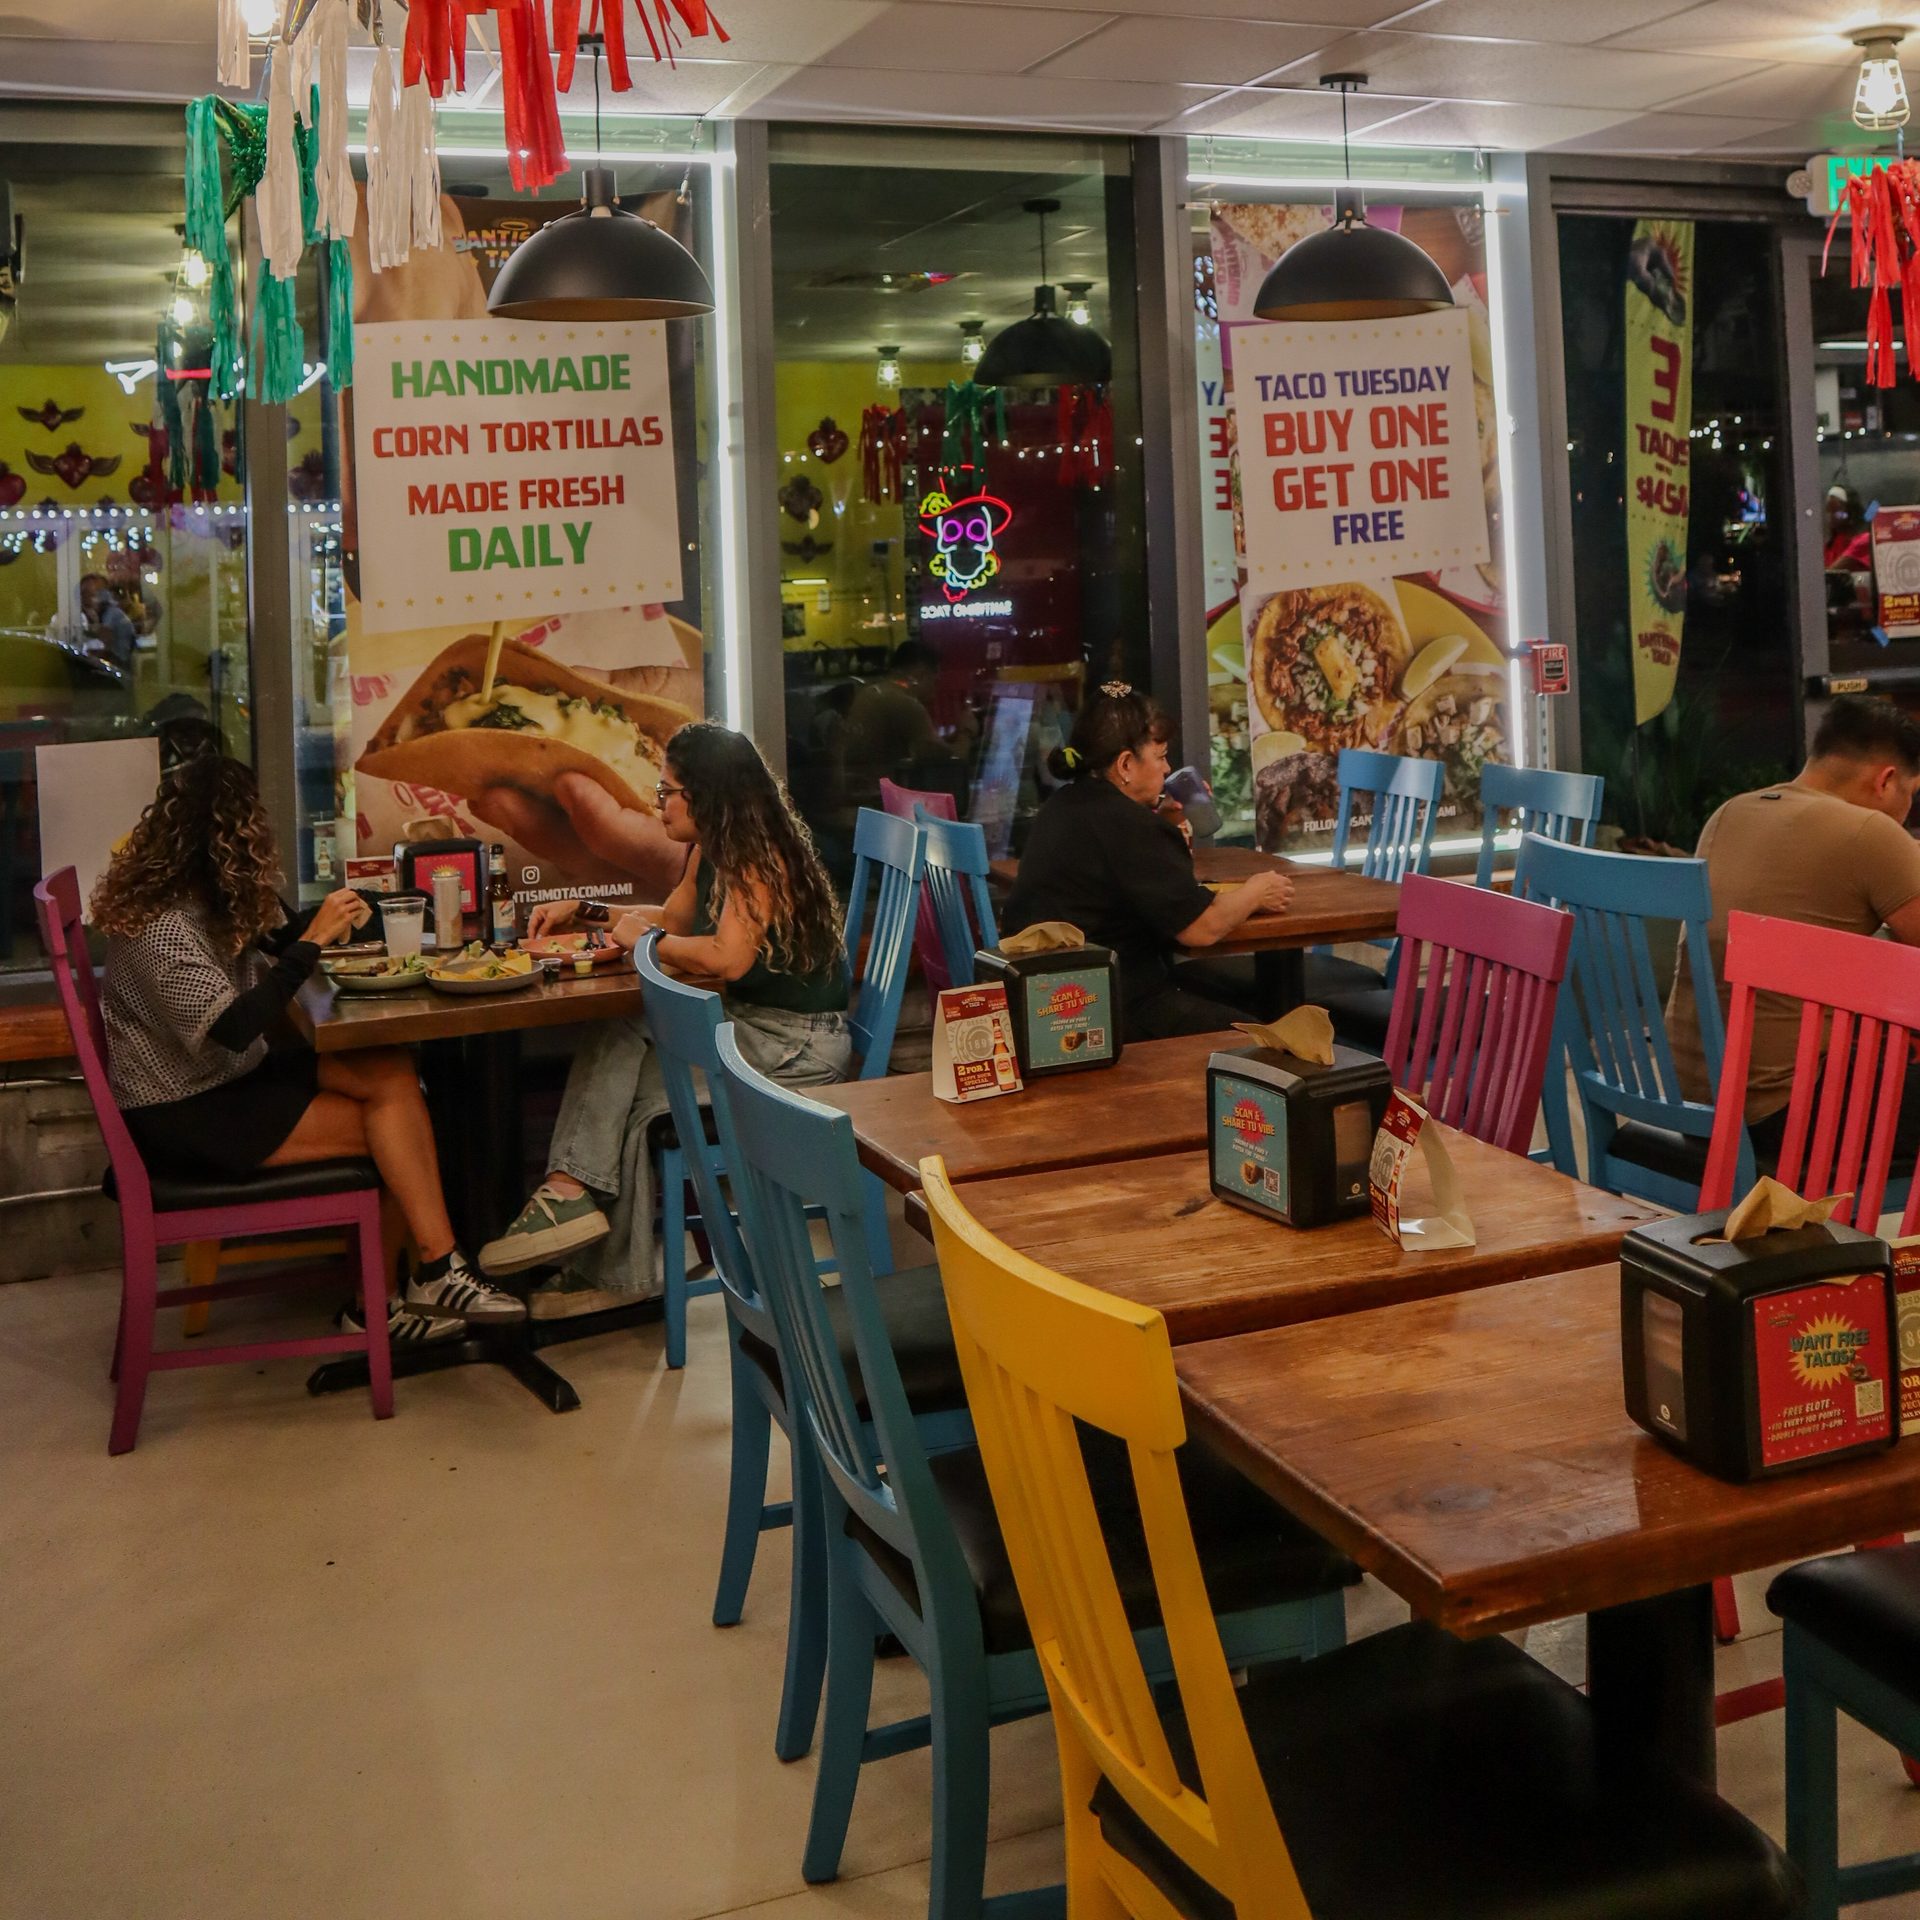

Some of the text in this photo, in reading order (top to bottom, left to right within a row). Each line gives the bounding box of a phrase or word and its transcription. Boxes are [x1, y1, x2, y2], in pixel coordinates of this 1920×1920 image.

[391, 354, 631, 399] HANDMADE
[1255, 372, 1327, 401] TACO
[1334, 365, 1450, 397] TUESDAY
[372, 416, 664, 458] CORN TORTILLAS
[1263, 408, 1354, 457] BUY
[1369, 403, 1450, 449] ONE
[408, 474, 625, 515] MADE FRESH
[1272, 463, 1354, 512] GET
[1369, 456, 1450, 504] ONE
[1333, 510, 1405, 545] FREE
[448, 521, 593, 572] DAILY
[1542, 648, 1564, 659] FIRE
[1036, 993, 1099, 1018] SHARE TU VIBE
[1050, 989, 1081, 1004] SCAN &
[957, 1065, 966, 1076] 2
[966, 1063, 984, 1074] FOR
[983, 1061, 991, 1071] 1
[964, 1077, 989, 1086] SPECIAL
[1234, 1106, 1260, 1120] SCAN &
[1222, 1115, 1276, 1136] SHARE TU VIBE
[1789, 1328, 1870, 1353] WANT FREE
[1803, 1348, 1856, 1368] TACOS?
[1901, 1374, 1920, 1388] OR
[1783, 1398, 1831, 1417] FREE ELOTE
[1783, 1418, 1805, 1428] EVERY
[1818, 1409, 1841, 1421] POINTS
